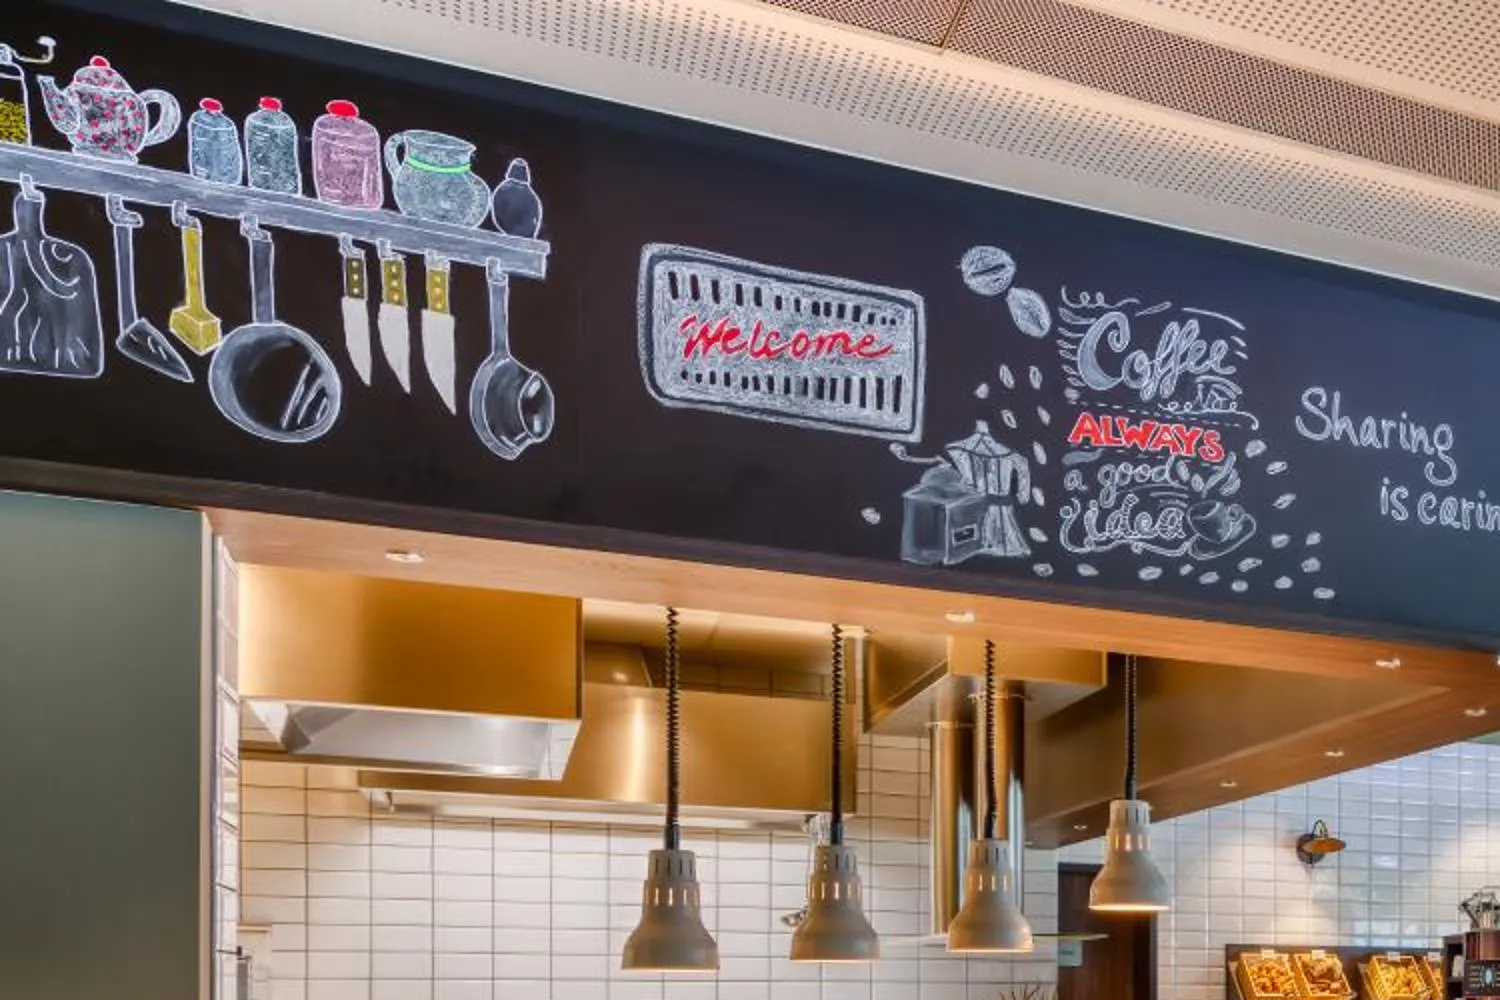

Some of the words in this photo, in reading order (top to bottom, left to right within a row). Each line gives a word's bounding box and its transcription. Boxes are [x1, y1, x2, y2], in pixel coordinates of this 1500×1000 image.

[679, 313, 895, 361] Welcome
[1077, 311, 1237, 400] Coffee
[1067, 411, 1226, 463] ALWAYS
[1295, 386, 1458, 486] Sharing
[1063, 468, 1089, 491] a
[1096, 455, 1189, 507] good
[1379, 476, 1409, 521] is
[1082, 493, 1187, 540] idea
